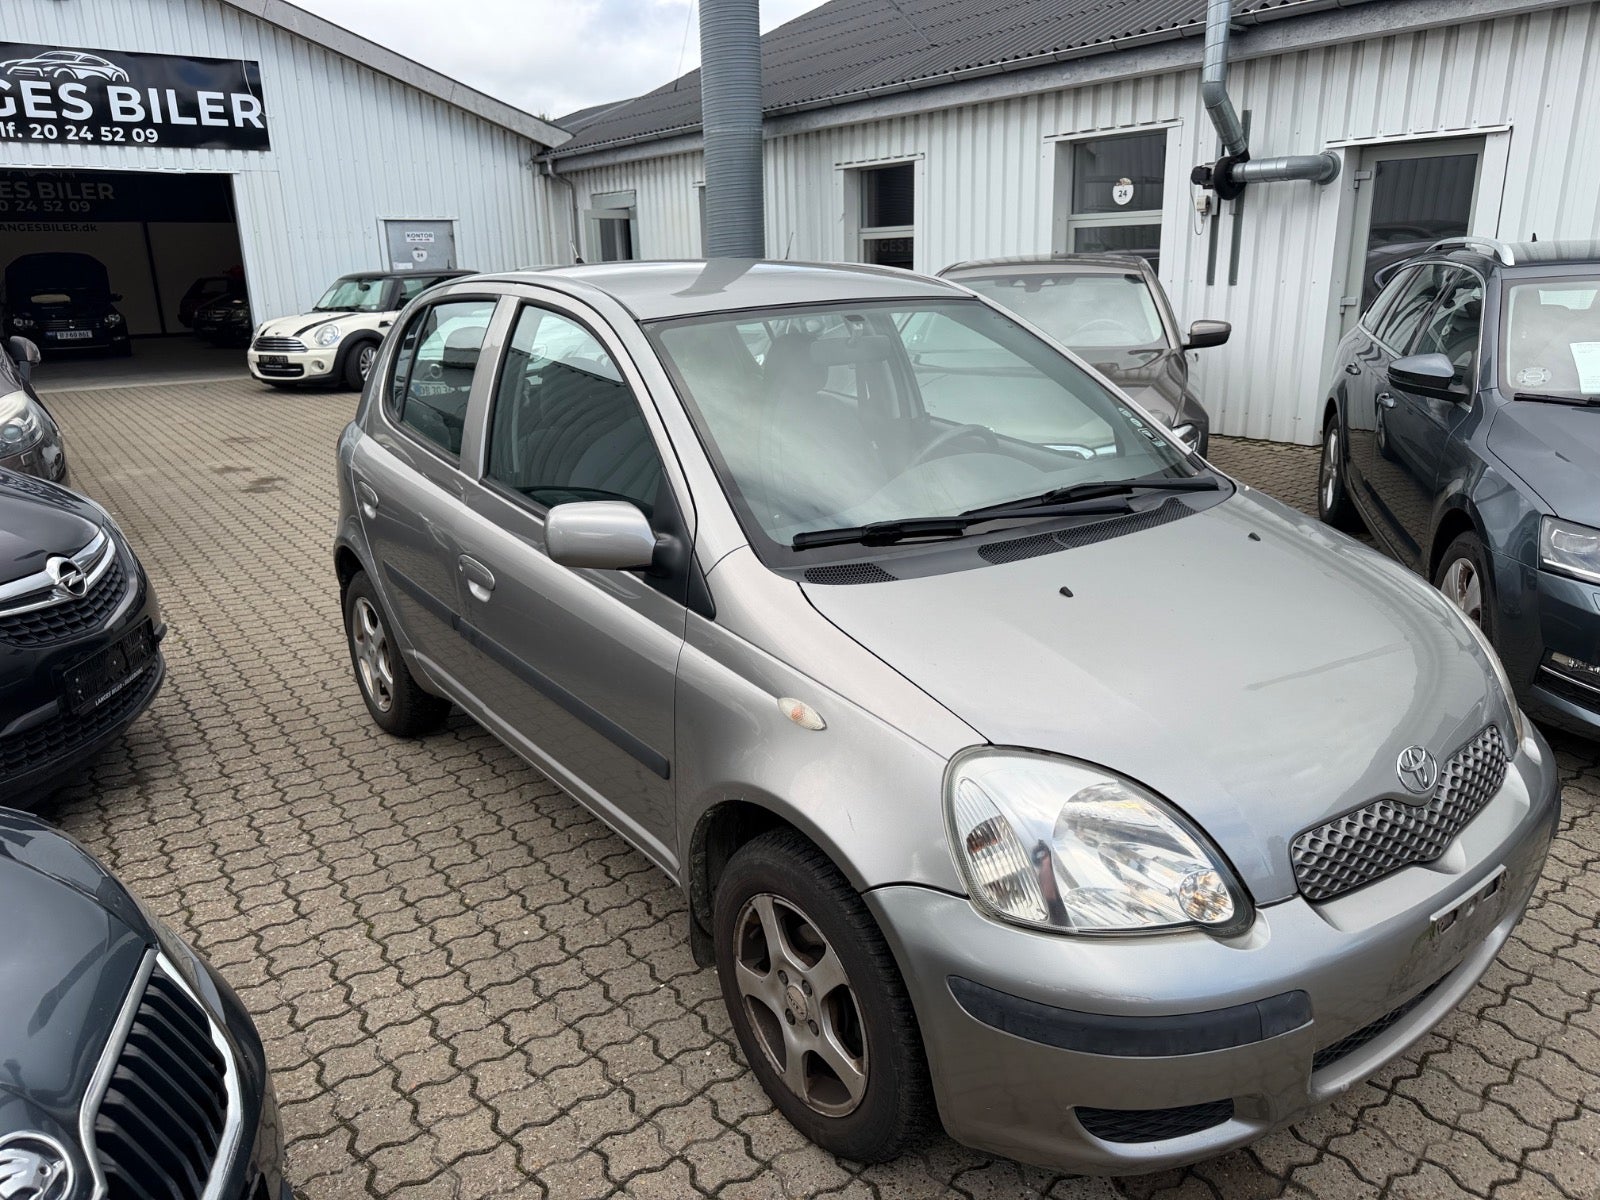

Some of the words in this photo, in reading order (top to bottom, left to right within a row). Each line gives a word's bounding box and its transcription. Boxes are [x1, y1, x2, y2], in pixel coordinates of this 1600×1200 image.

[106, 85, 265, 128] BILER
[28, 123, 58, 140] 20
[64, 124, 94, 141] 24
[100, 126, 126, 142] 52
[132, 128, 159, 143] 09
[36, 181, 116, 200] BILER
[1118, 190, 1128, 198] 24
[14, 200, 38, 212] 24
[43, 200, 65, 212] 52
[69, 200, 91, 213] 09
